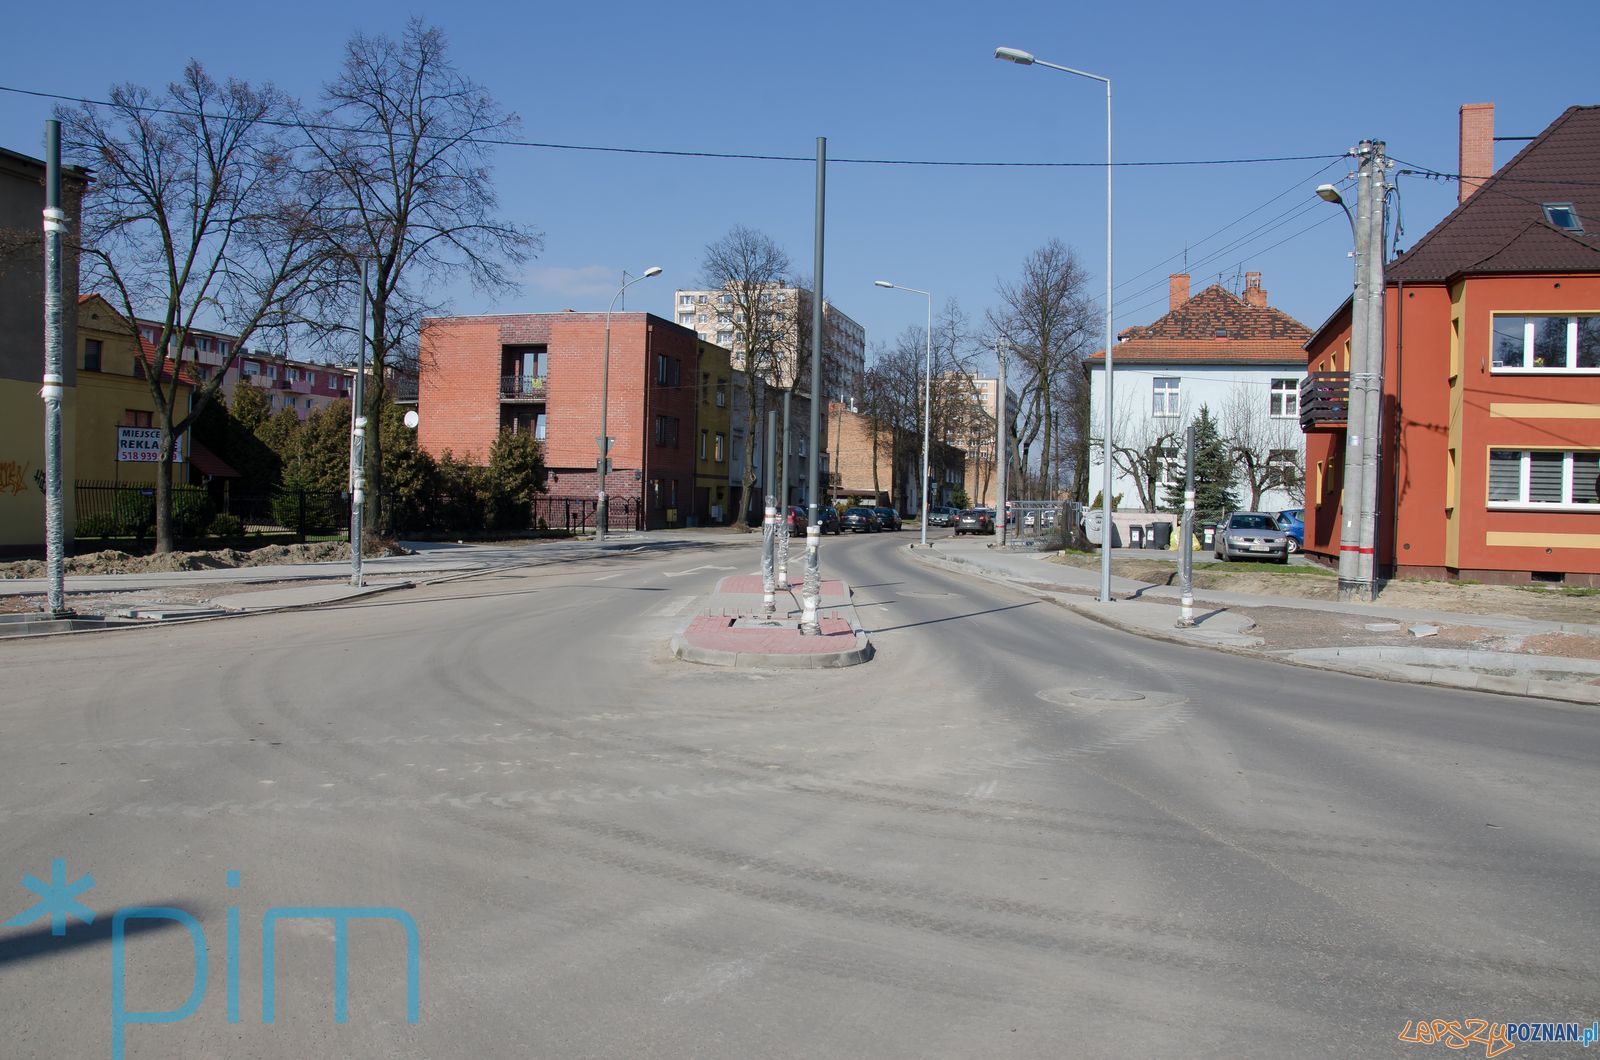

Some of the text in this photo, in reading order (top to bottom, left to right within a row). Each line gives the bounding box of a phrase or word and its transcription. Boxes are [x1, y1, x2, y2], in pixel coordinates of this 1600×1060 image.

[122, 429, 161, 438] MIEJSCE
[122, 451, 158, 461] 518 939
